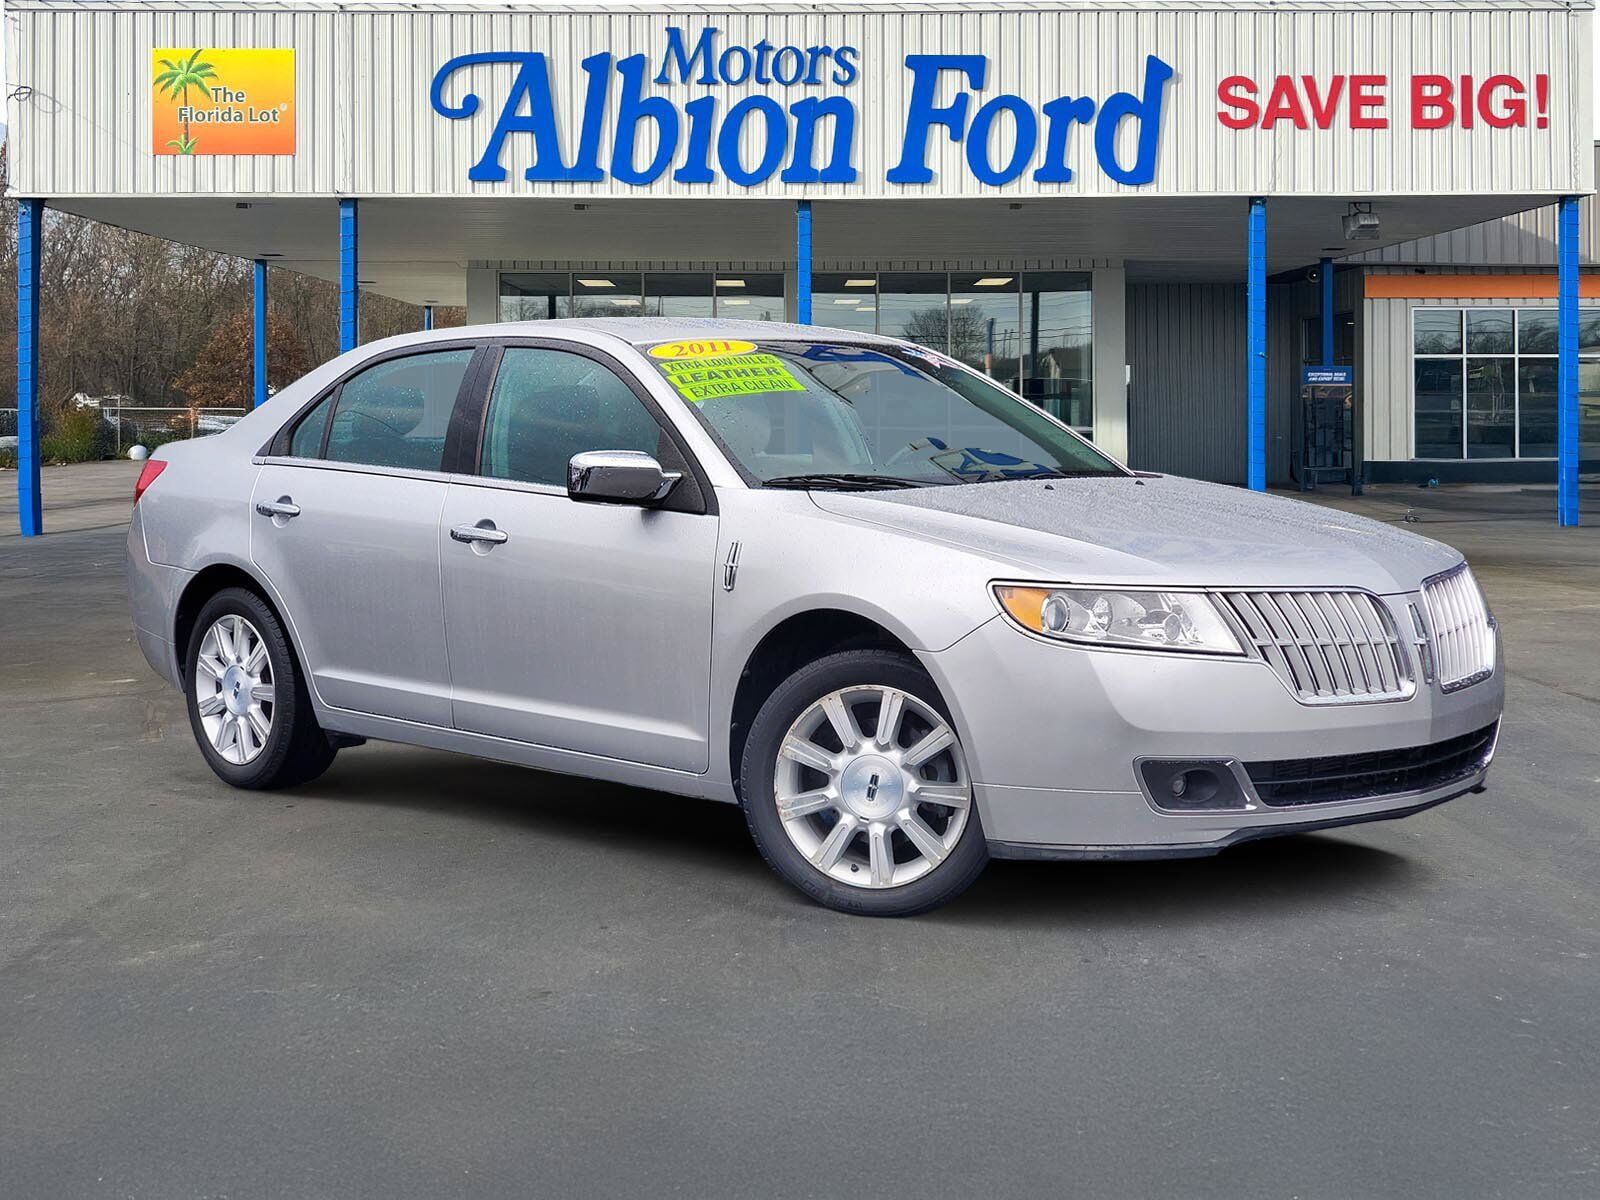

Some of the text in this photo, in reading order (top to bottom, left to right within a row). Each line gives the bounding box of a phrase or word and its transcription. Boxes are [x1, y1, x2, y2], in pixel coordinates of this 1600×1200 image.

[653, 27, 858, 86] Motors
[211, 87, 245, 102] The
[1217, 74, 1549, 130] SAVE BIG!
[178, 107, 279, 122] Florida Lot
[430, 51, 1173, 187] Albion Ford
[670, 341, 732, 357] 2011
[666, 359, 701, 372] XTRA
[733, 354, 776, 366] MILES
[676, 366, 782, 385] LEATHER
[690, 378, 793, 398] EXTRA CLEAN
